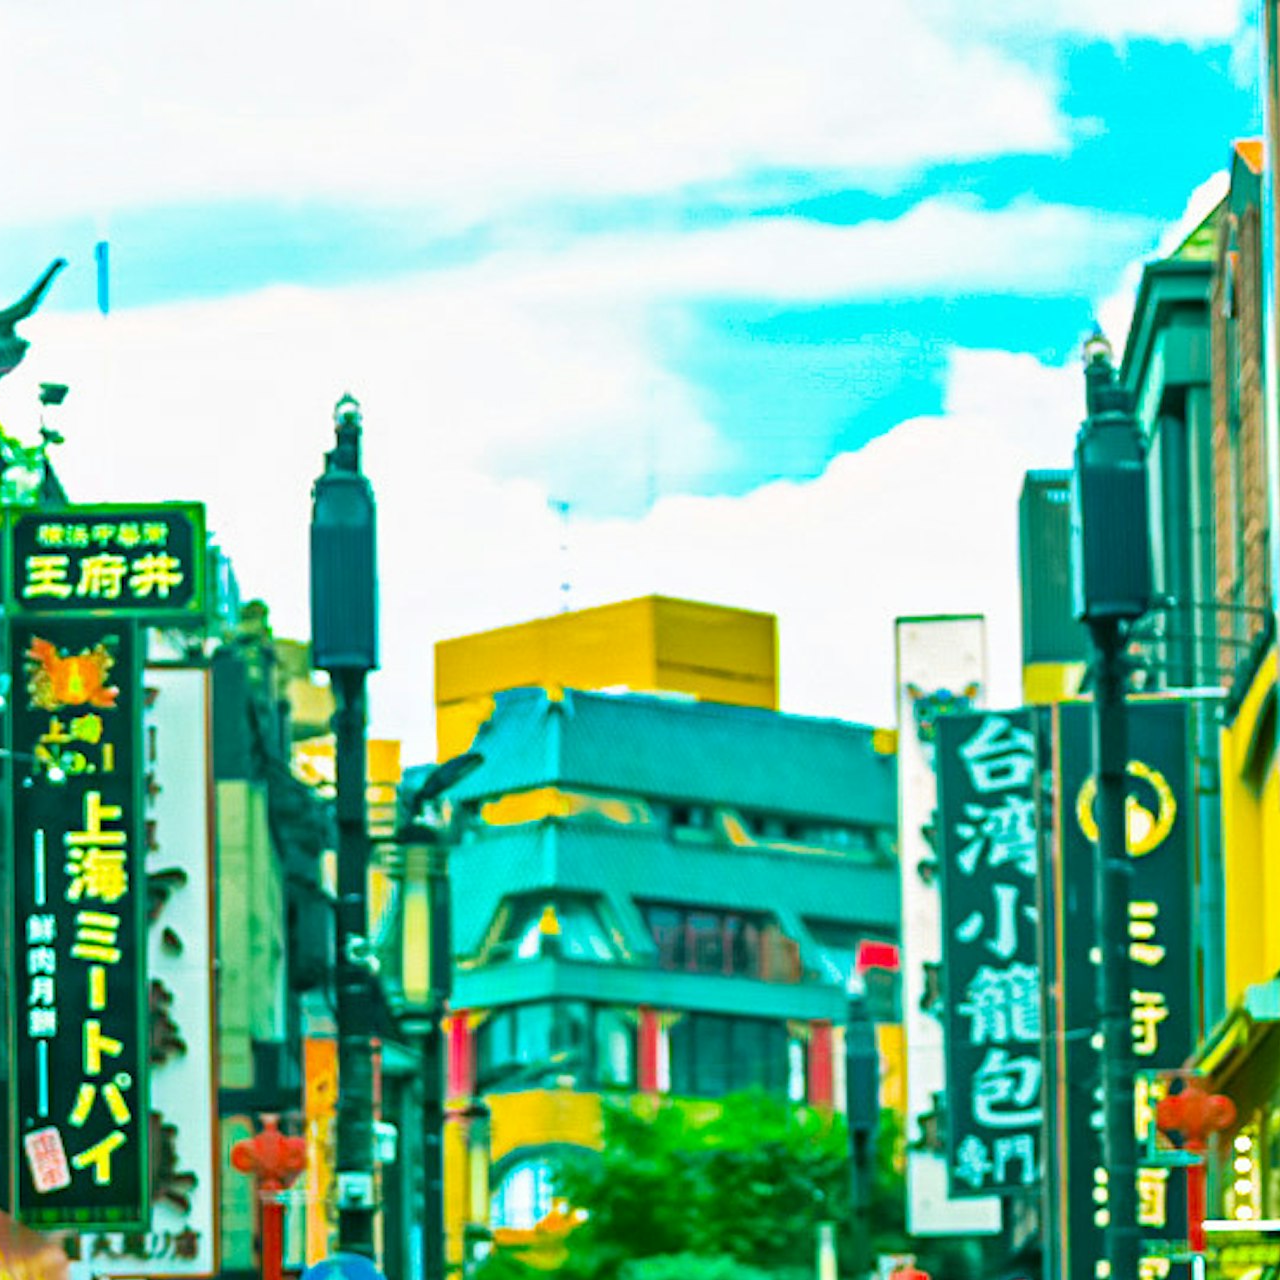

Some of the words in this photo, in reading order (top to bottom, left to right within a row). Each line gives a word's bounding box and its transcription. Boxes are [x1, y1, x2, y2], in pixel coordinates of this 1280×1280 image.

[23, 552, 184, 599] 王府井
[64, 791, 132, 1185] 上海ミートパイ
[956, 716, 1042, 1127] 台湾小籠包
